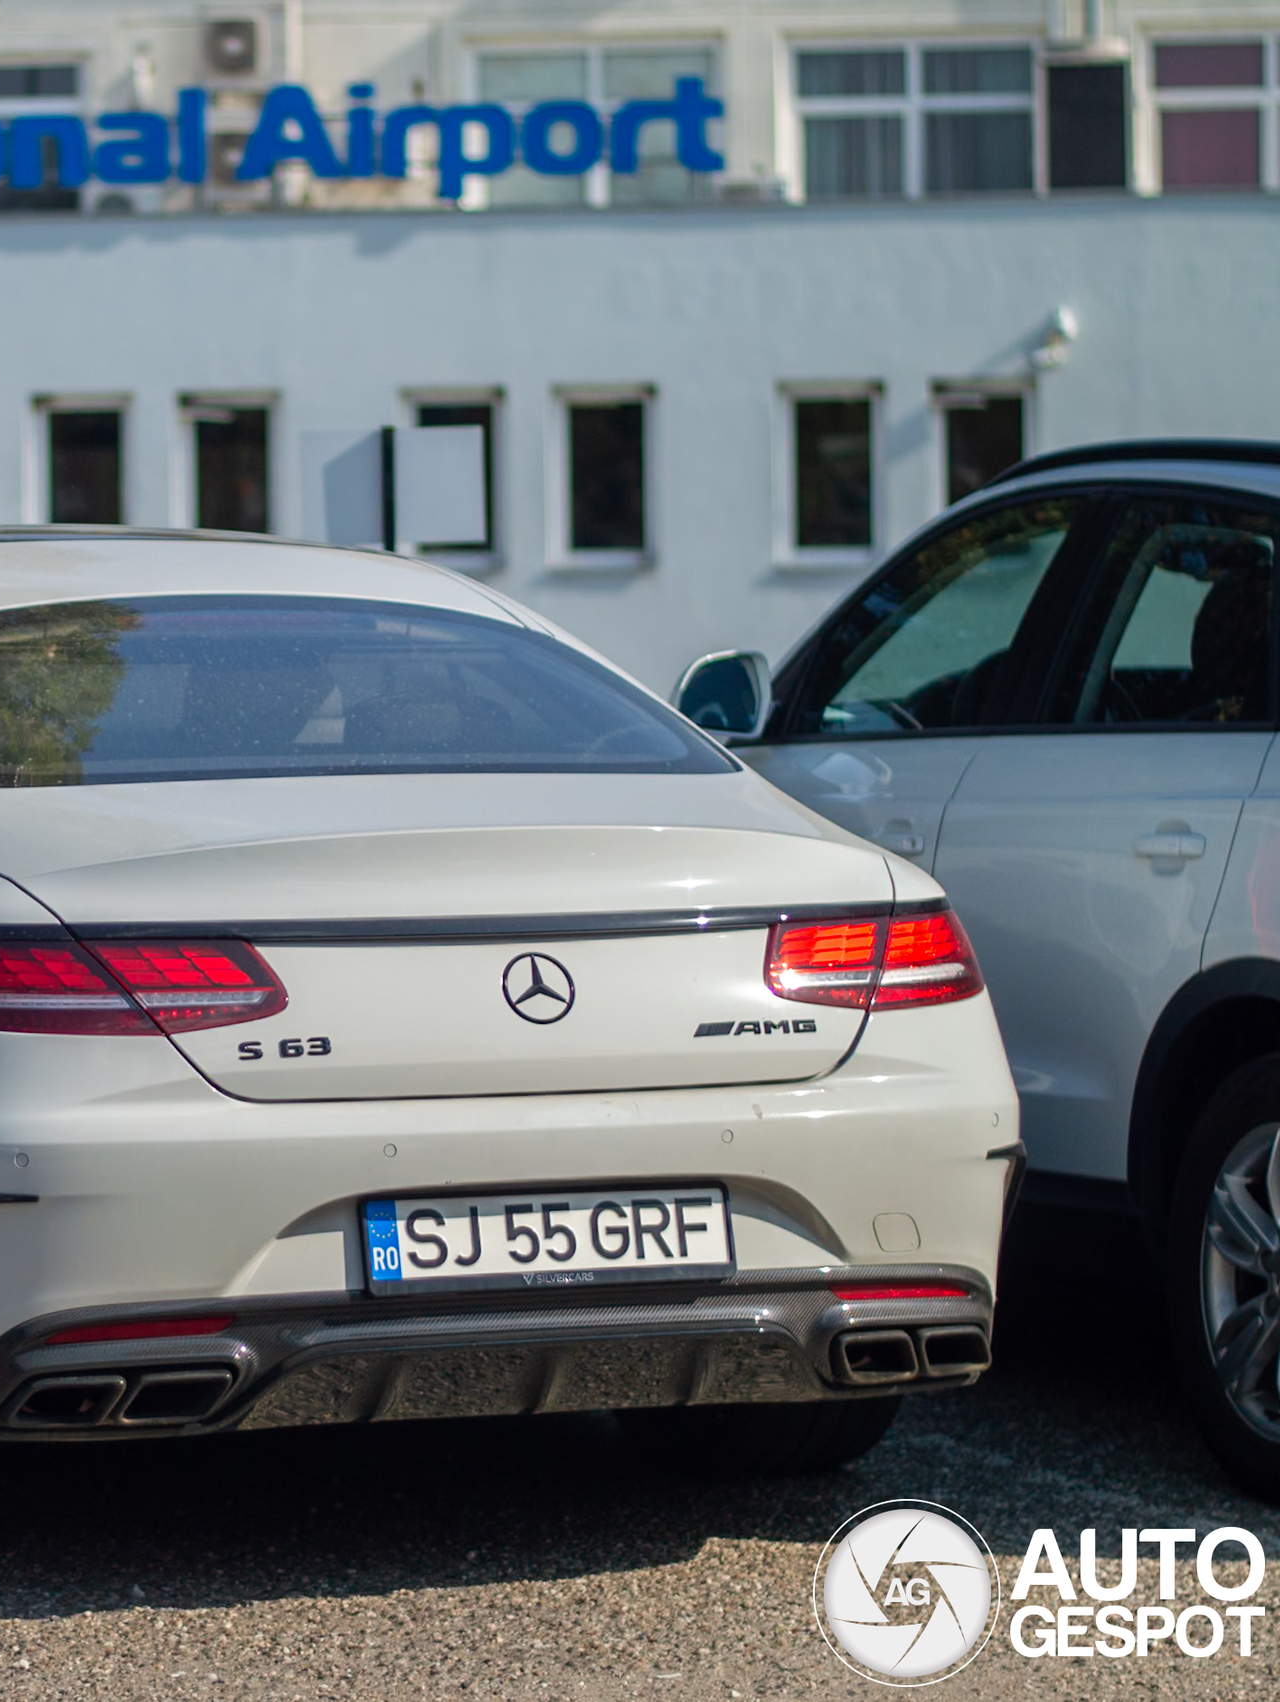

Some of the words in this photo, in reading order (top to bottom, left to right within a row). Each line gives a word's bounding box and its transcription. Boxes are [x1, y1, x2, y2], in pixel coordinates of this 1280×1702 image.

[236, 75, 724, 201] Airport
[733, 1019, 817, 1036] AMG
[237, 1041, 264, 1061] S
[278, 1036, 332, 1059] 63
[405, 1205, 483, 1269] SJ
[504, 1202, 578, 1263] 55
[590, 1197, 713, 1260] GRF
[372, 1245, 400, 1272] RO
[536, 1271, 595, 1285] SILVERCARS
